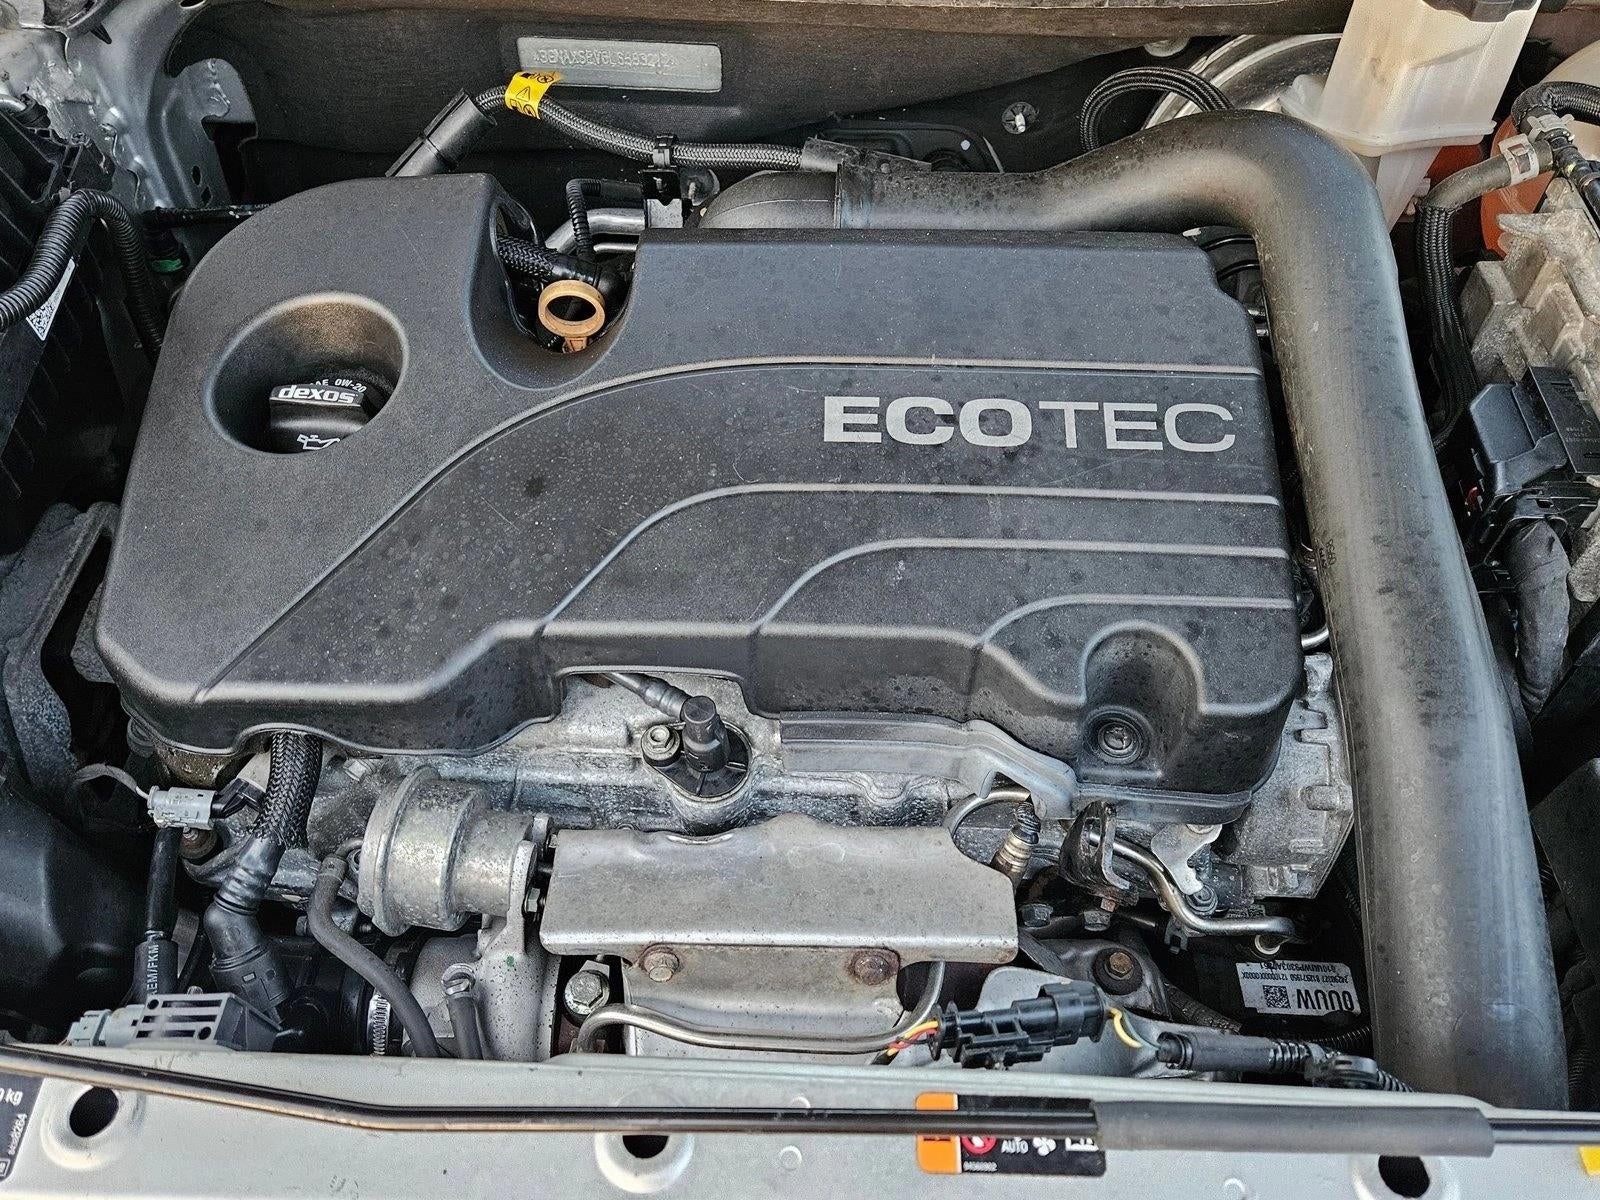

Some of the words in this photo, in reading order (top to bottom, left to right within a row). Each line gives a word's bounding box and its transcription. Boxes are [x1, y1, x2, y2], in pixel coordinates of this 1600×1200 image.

[278, 384, 356, 404] dexos
[334, 378, 367, 393] 0W-20
[823, 396, 1237, 453] ECOTEC
[1296, 988, 1355, 1012] 0UUW
[6, 1087, 24, 1106] kg
[1001, 1138, 1029, 1154] AUTO
